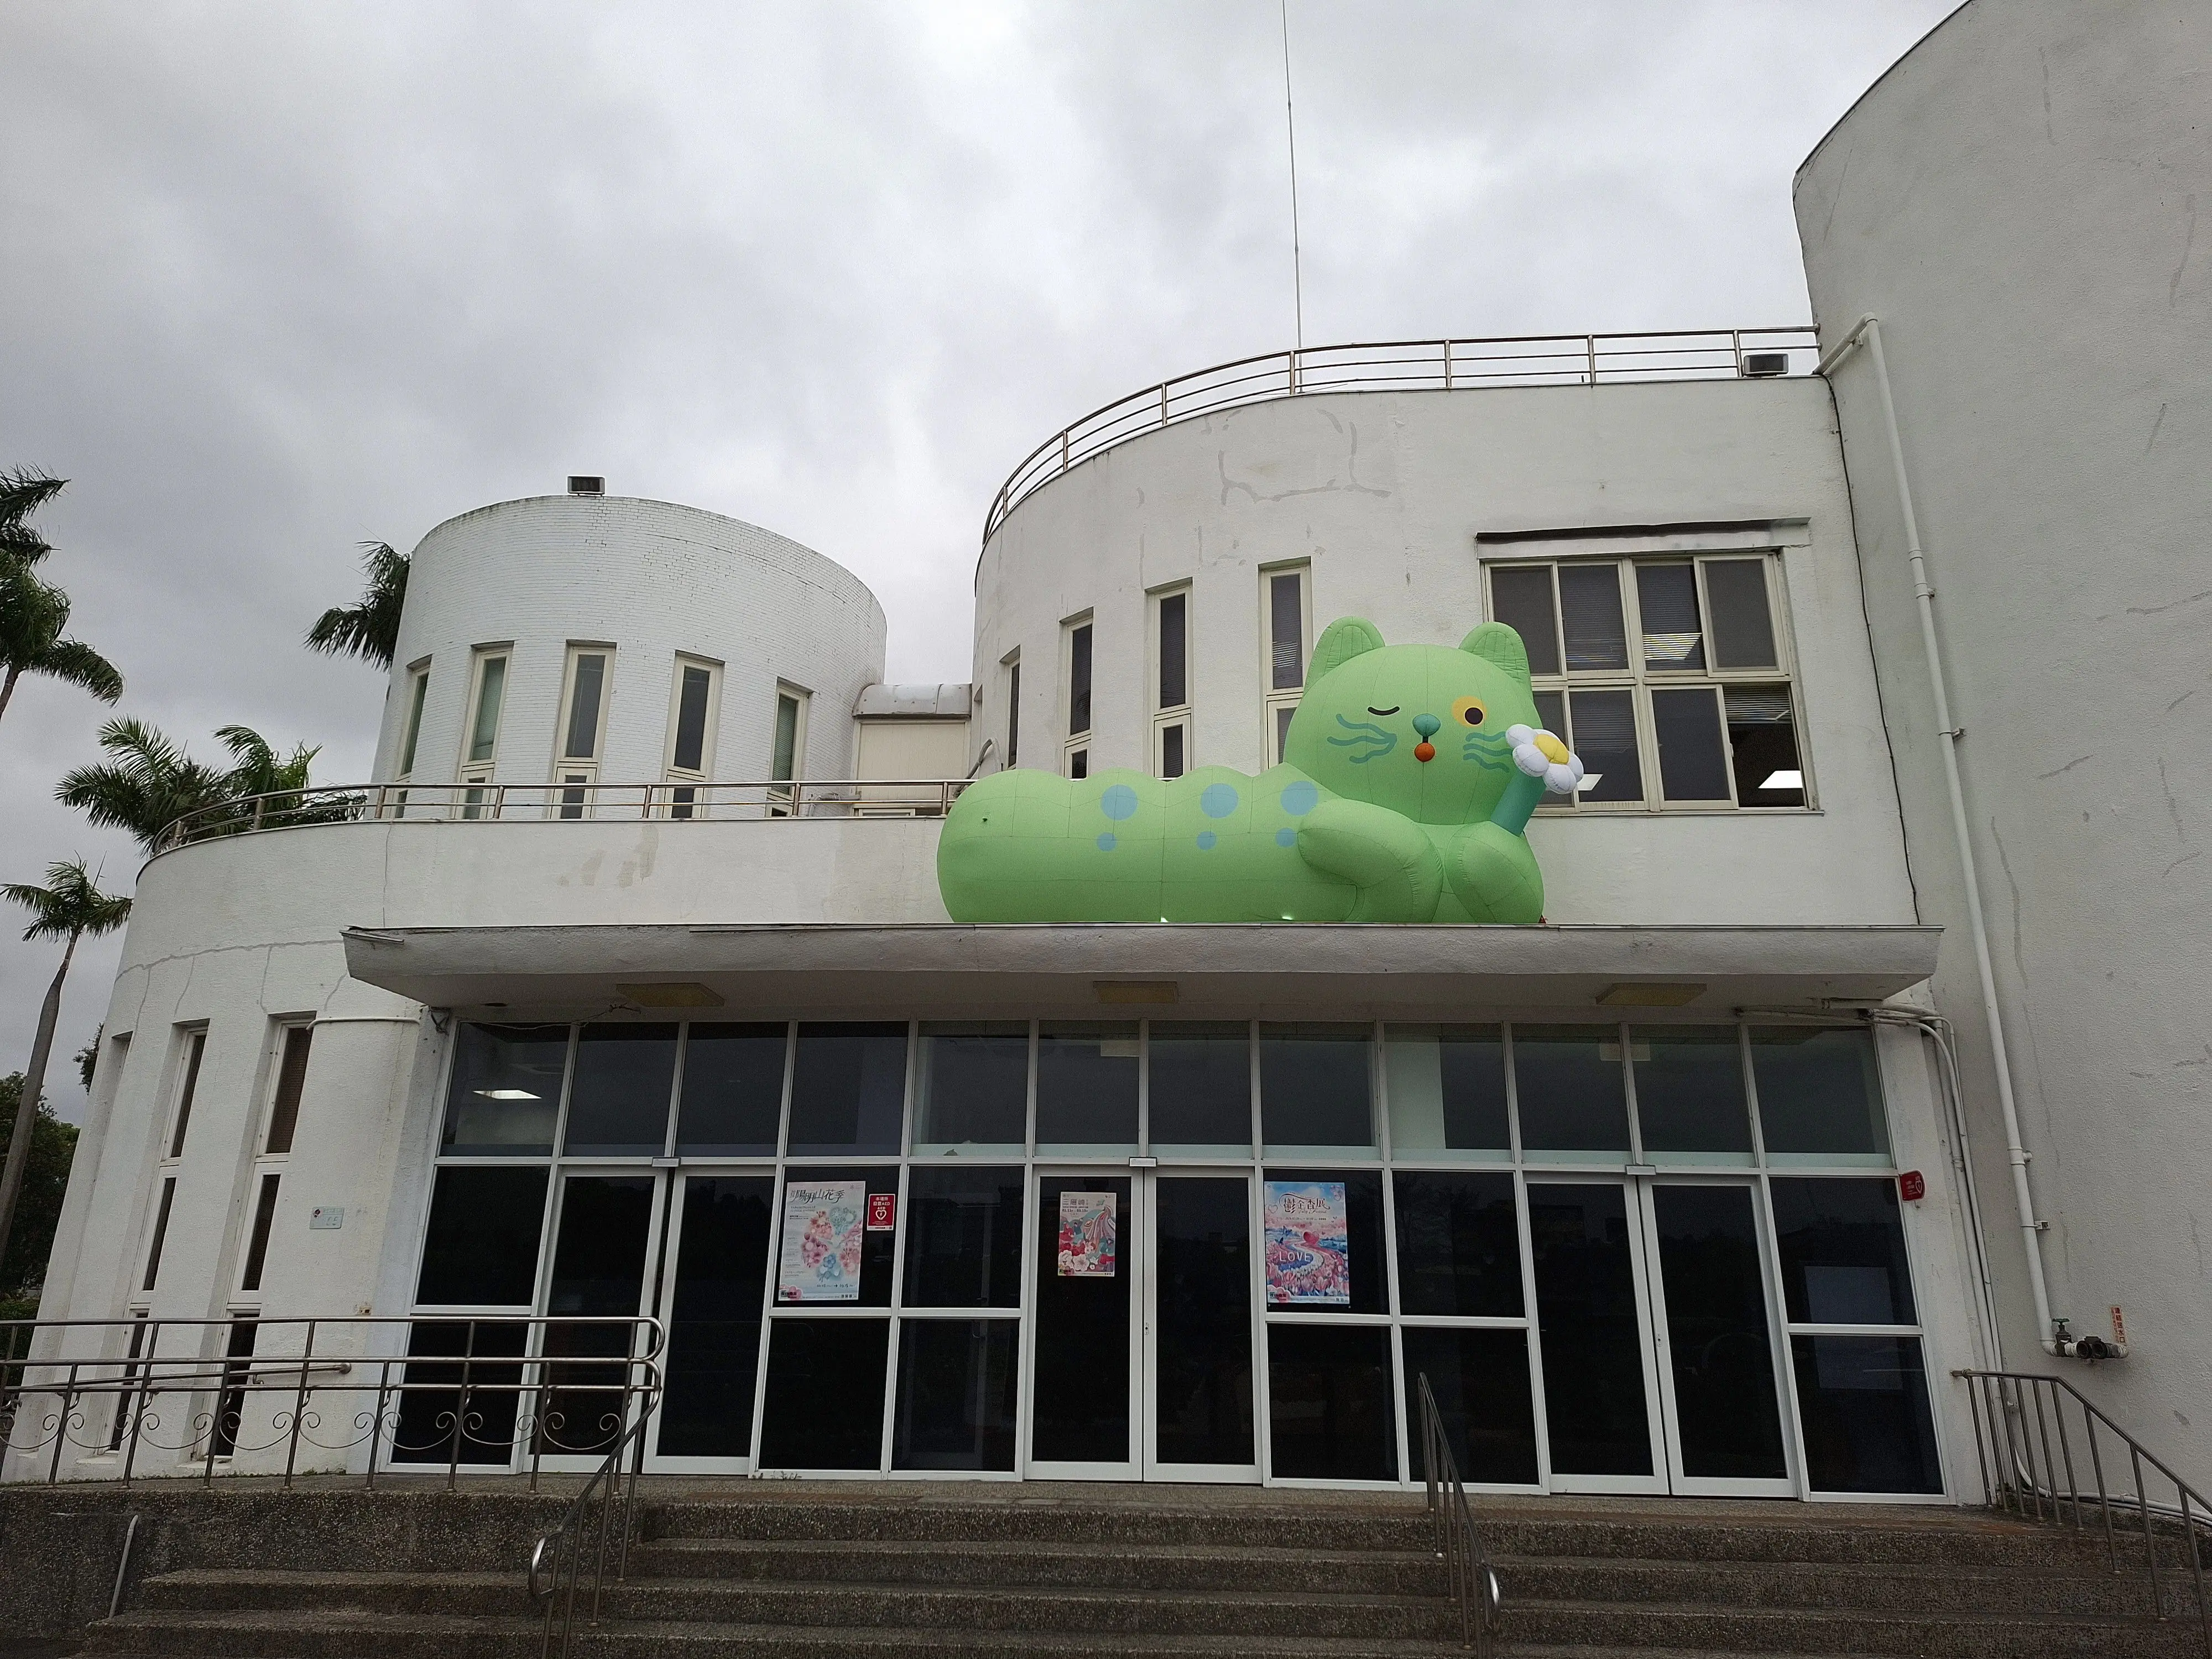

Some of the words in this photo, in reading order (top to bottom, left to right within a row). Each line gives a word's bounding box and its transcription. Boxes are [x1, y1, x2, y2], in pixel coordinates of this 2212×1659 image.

[1284, 1197, 1331, 1213] 鬱金香展
[1279, 1251, 1311, 1262] LOVE
